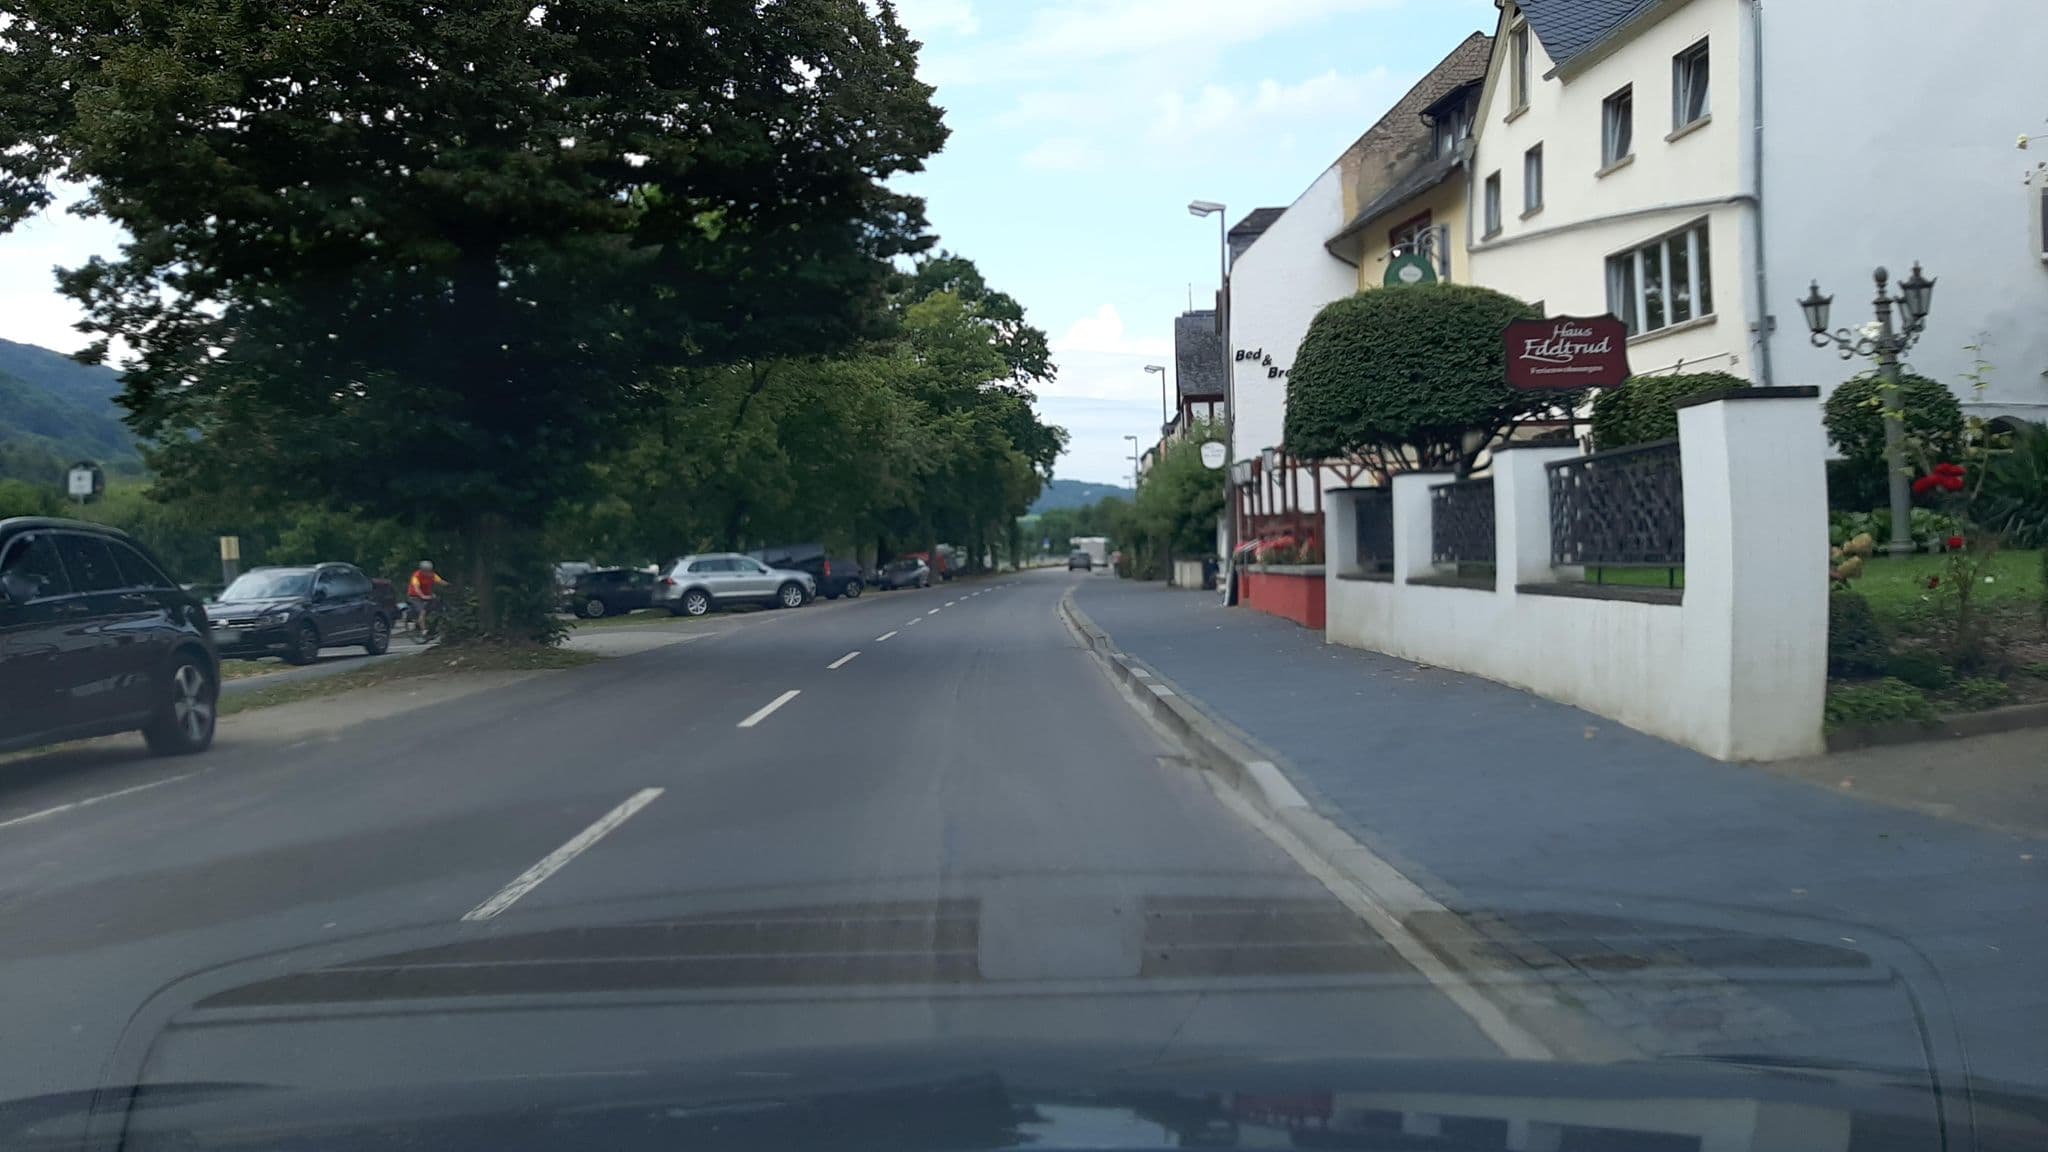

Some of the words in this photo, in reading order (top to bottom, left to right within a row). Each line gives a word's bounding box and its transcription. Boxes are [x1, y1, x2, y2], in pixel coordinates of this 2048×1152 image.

[1551, 321, 1593, 340] Haus
[1235, 347, 1262, 361] Bed
[1262, 354, 1272, 366] &
